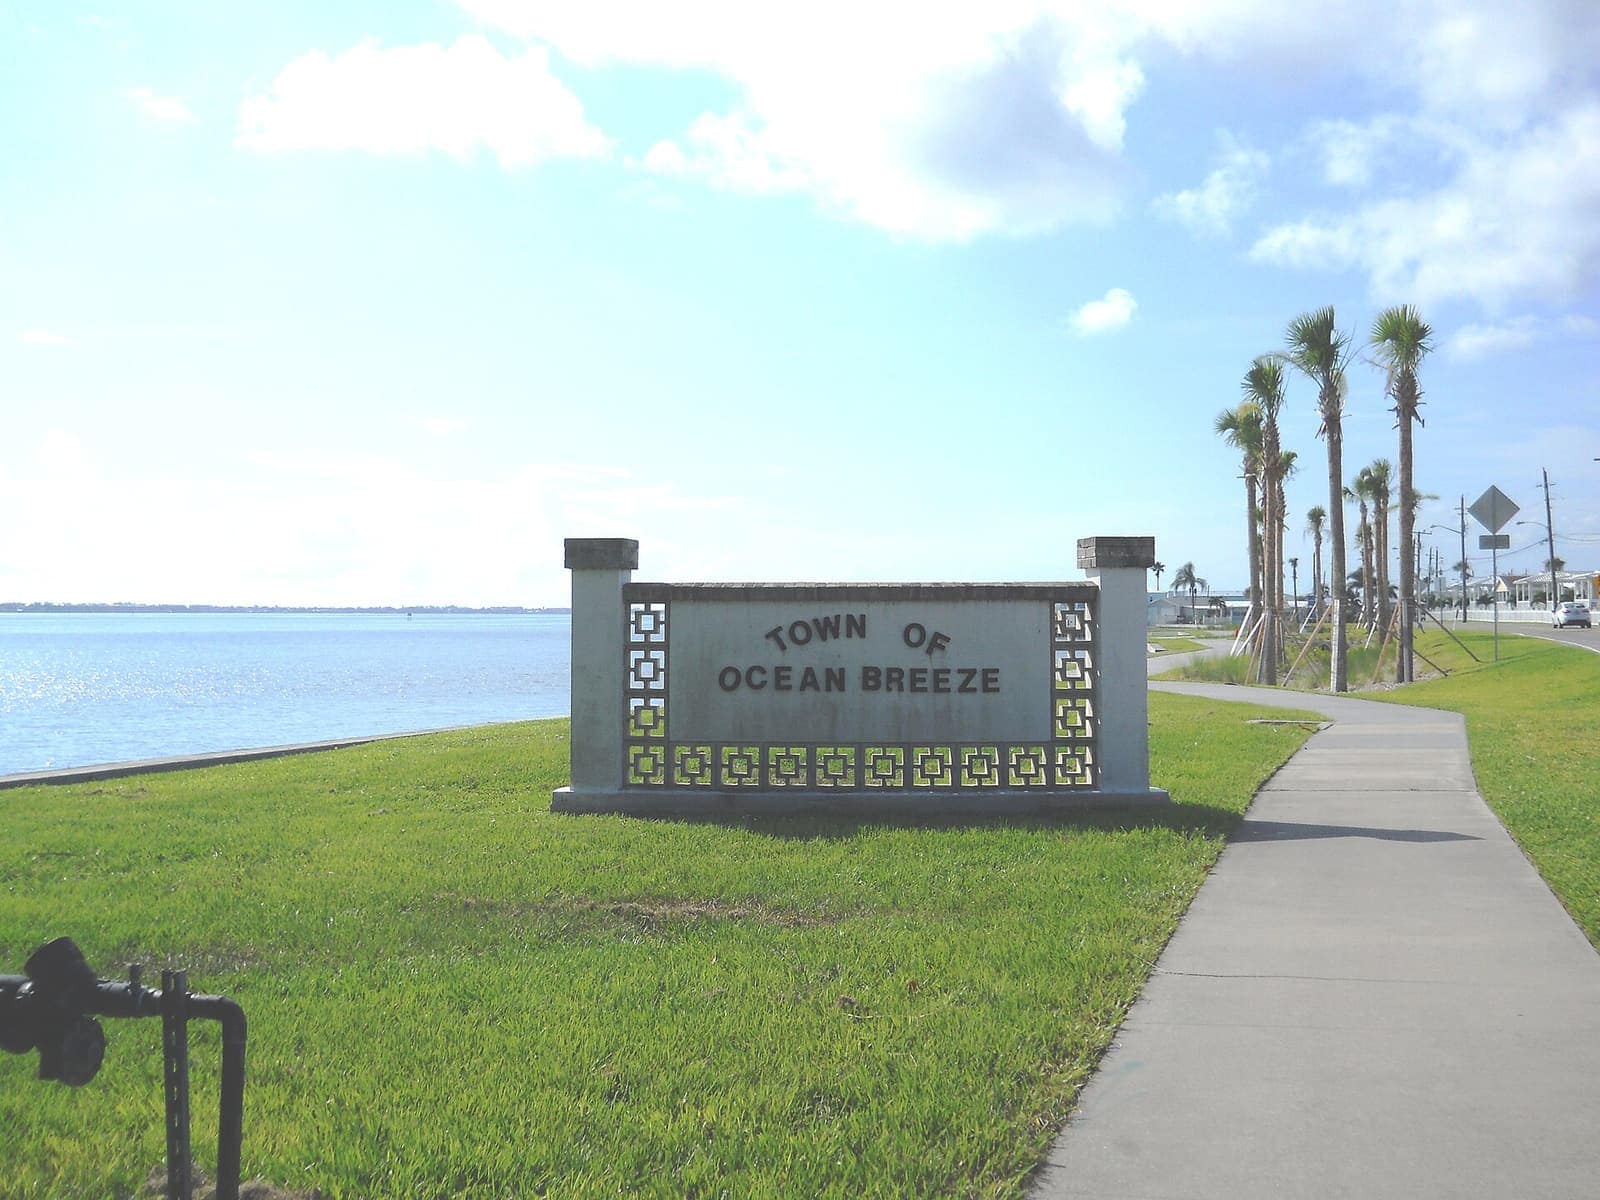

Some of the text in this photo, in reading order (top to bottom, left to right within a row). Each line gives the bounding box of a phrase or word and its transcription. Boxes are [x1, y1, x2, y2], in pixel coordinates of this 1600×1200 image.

[765, 614, 951, 655] TOWN OF
[718, 665, 1000, 693] OCEAN BREEZE
